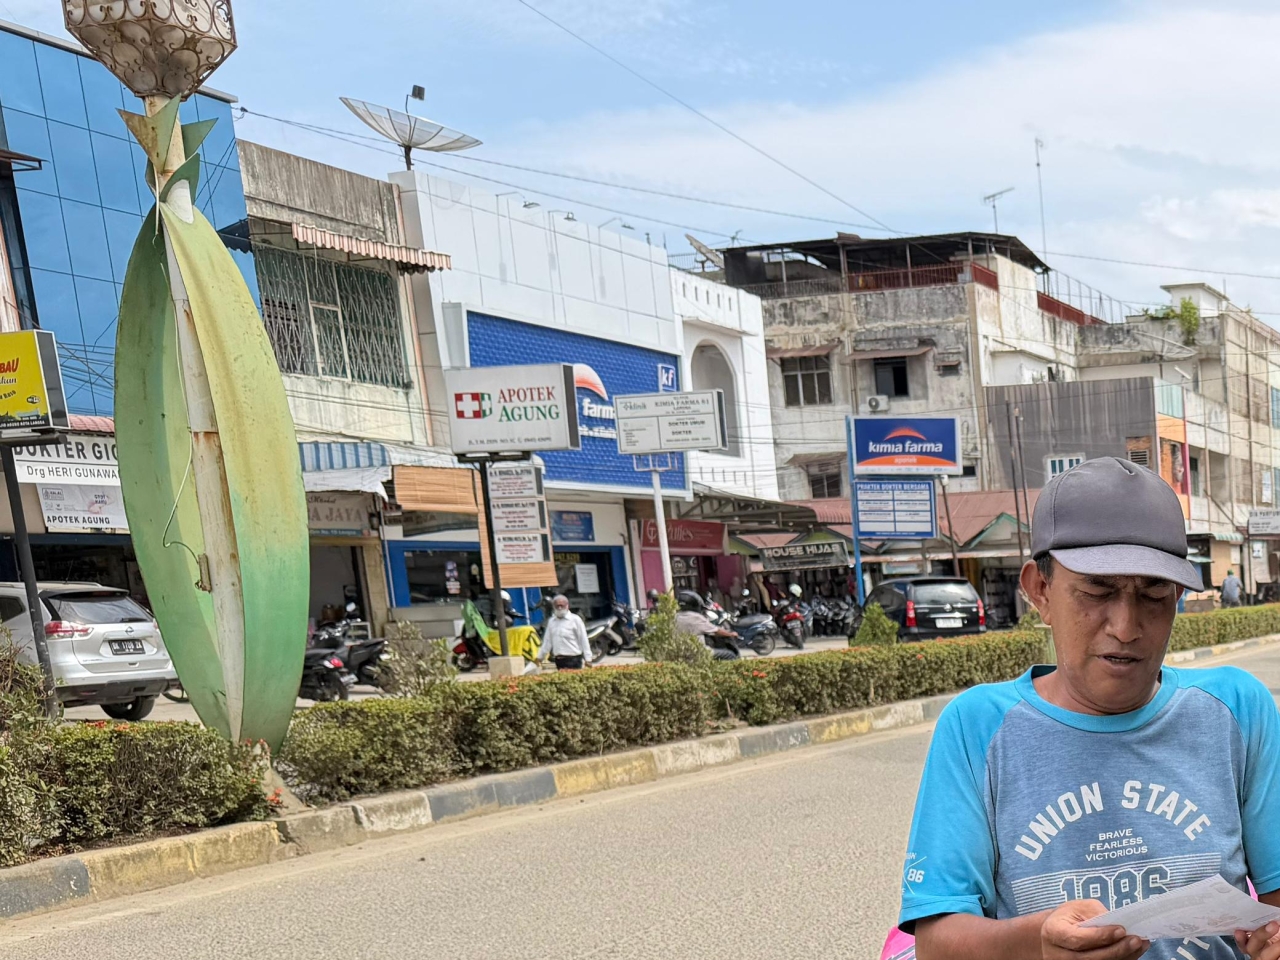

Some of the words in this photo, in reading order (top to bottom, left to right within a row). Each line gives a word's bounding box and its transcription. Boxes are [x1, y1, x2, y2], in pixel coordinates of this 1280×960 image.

[498, 386, 556, 403] APOTEK
[499, 405, 560, 422] AGUNG
[582, 397, 615, 419] farm
[869, 441, 902, 453] kimia
[905, 441, 943, 453] farma
[27, 466, 45, 478] Drg
[48, 467, 72, 477] HERI
[75, 468, 118, 479] GUNAWA
[764, 546, 804, 558] HOUSE
[805, 543, 840, 555] HIJAB
[1015, 782, 1104, 861] UNION
[1121, 780, 1211, 841] STATE
[1098, 828, 1133, 841] BRAVE
[1089, 836, 1143, 852] FEARLESS
[1085, 845, 1148, 862] VICTORIOUS
[907, 868, 925, 883] 86
